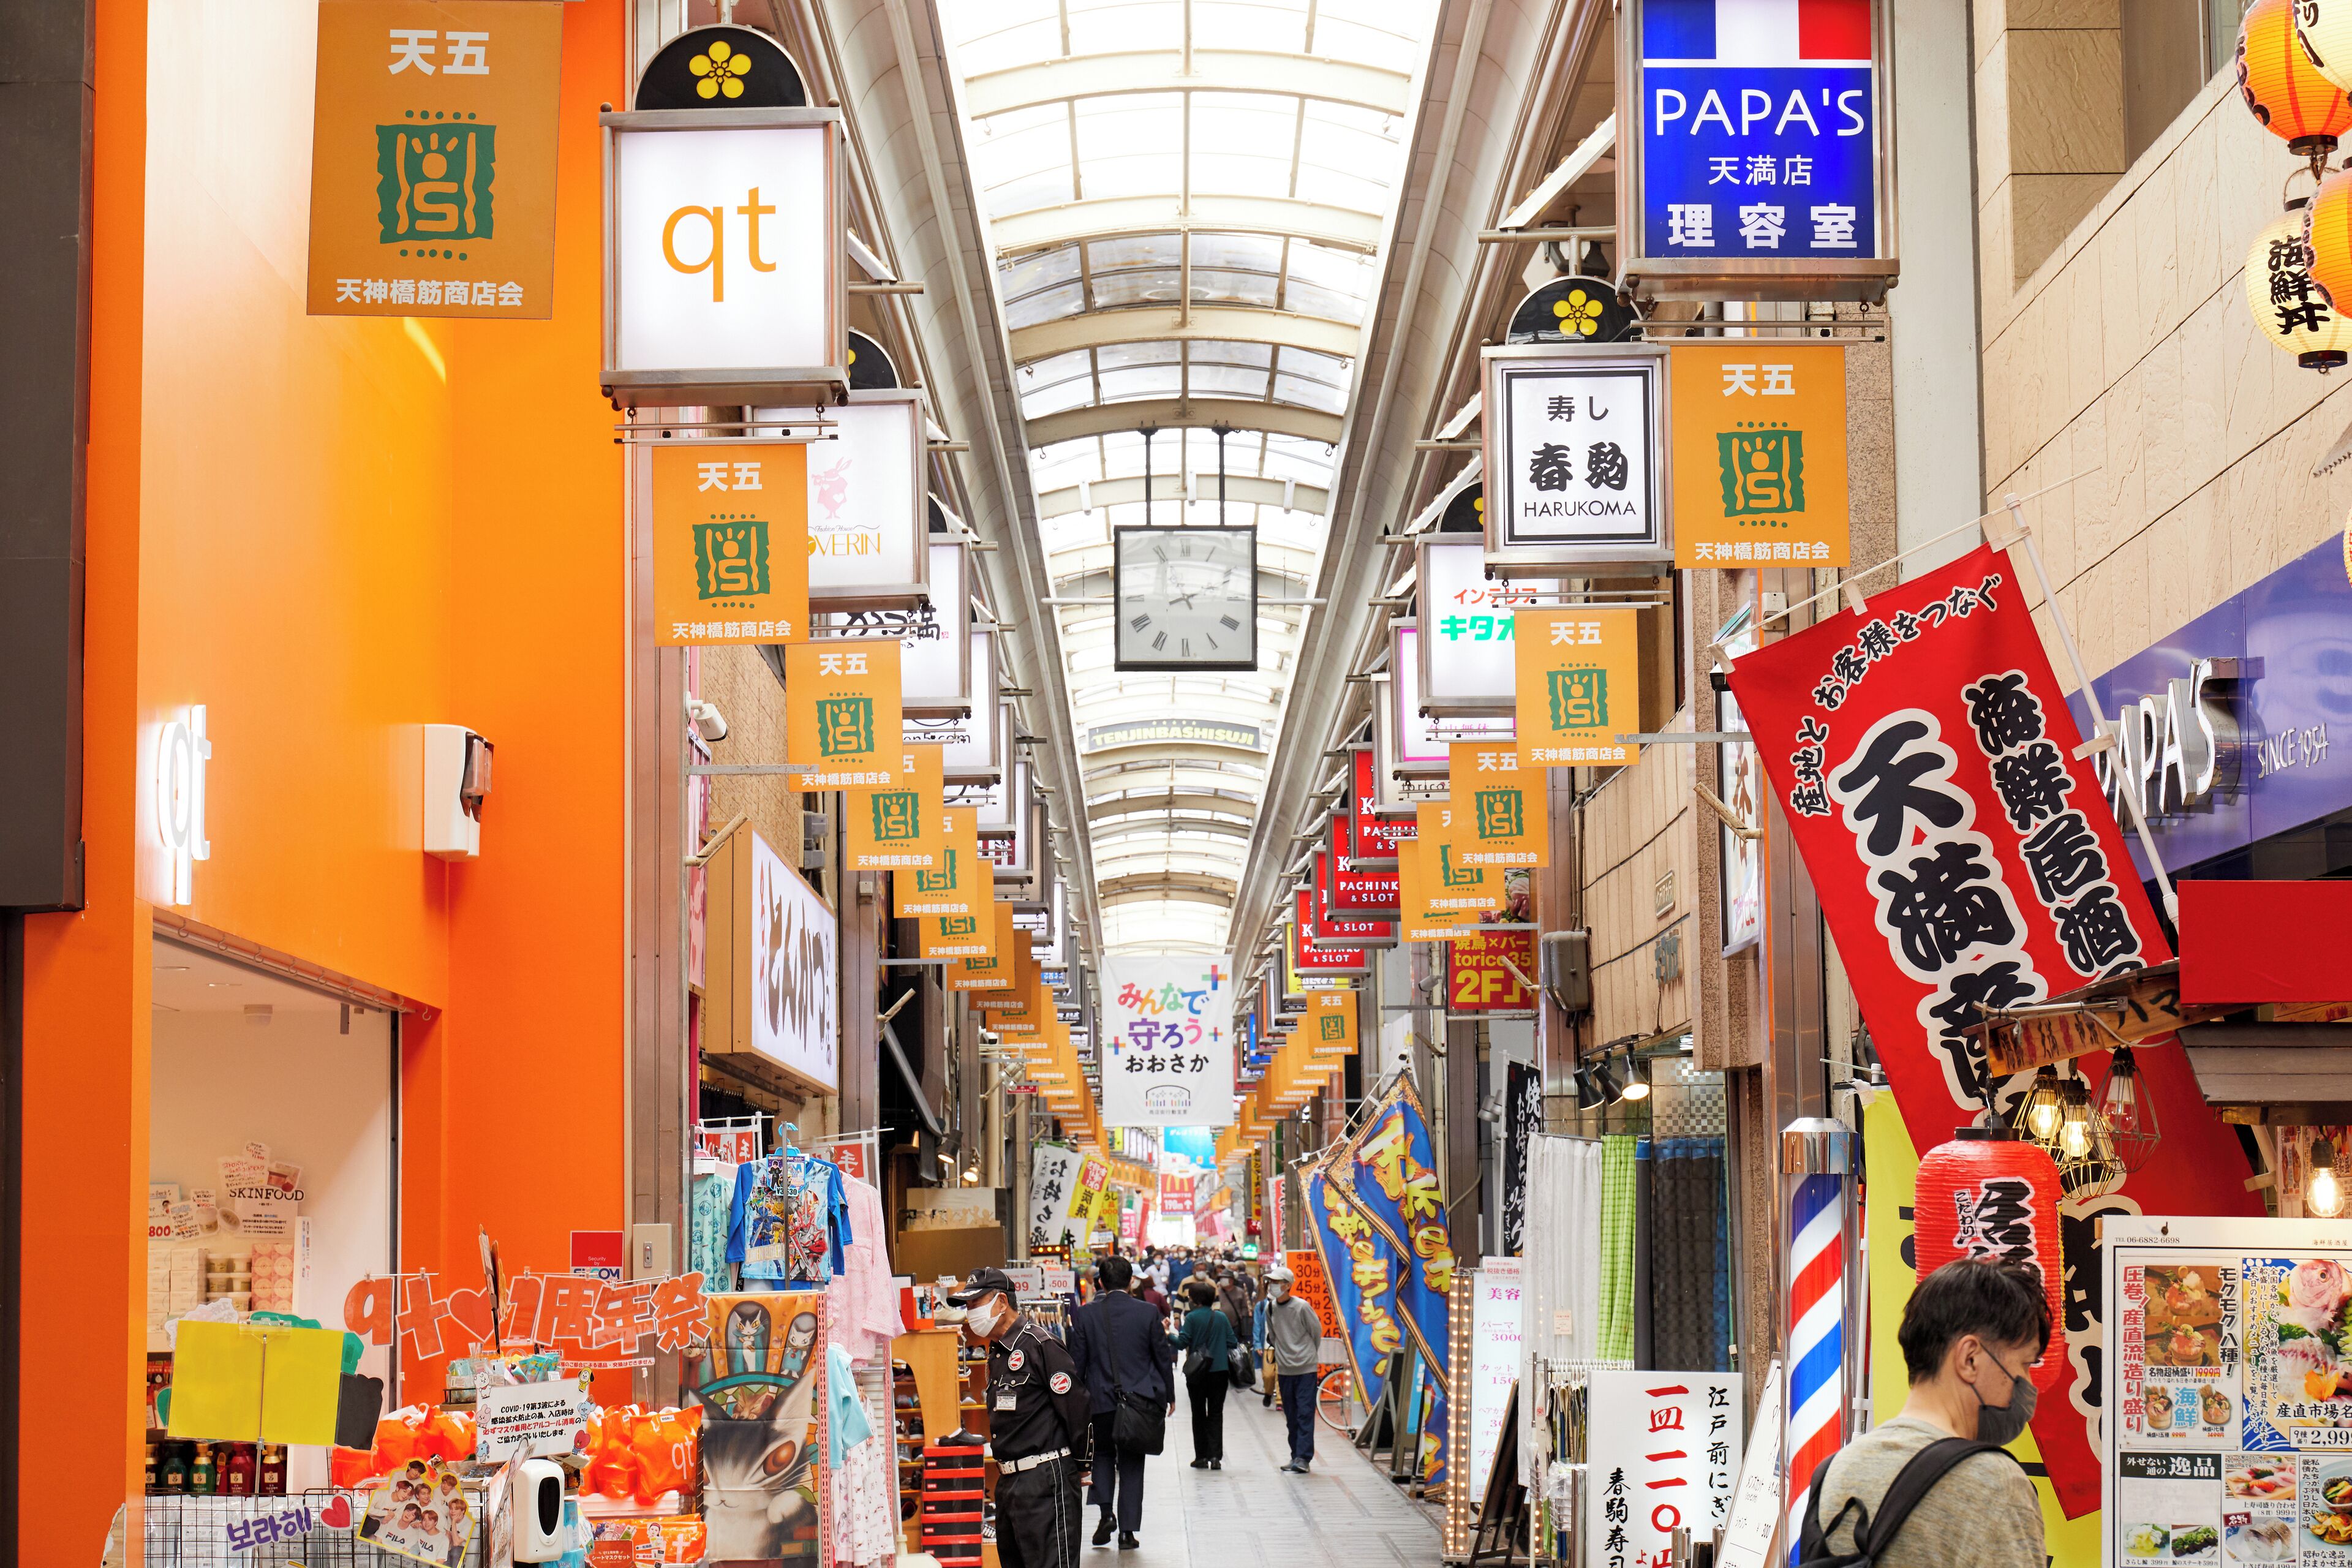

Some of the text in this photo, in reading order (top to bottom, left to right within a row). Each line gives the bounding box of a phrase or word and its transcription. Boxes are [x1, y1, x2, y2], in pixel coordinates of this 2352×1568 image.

[388, 29, 489, 75] 天五
[1656, 88, 1864, 137] PAPA'S
[1708, 154, 1812, 186] 天満店
[1667, 202, 1857, 249] 理容室
[662, 186, 776, 302] qt
[336, 278, 524, 307] 天神橋筋商店会
[1722, 364, 1795, 398] 天五
[1548, 395, 1608, 423] 寿し
[697, 462, 762, 492] 天五
[1524, 500, 1636, 518] HARUKOMA
[1695, 542, 1830, 560] 天神橋筋商店会
[672, 620, 791, 639] 天神橋筋商店会
[1550, 622, 1602, 646] 天五
[1812, 574, 2003, 712] お客様をつなぐ
[819, 654, 868, 676] 天五
[1091, 726, 1254, 746] TENJINBASHISUJI
[1531, 747, 1626, 761] 天神橋筋商店会
[2258, 722, 2329, 778] SINCE 1954
[1477, 752, 1518, 771] 天五
[802, 771, 891, 786] 天神橋筋商店会
[158, 704, 211, 905] qt
[858, 854, 933, 866] 天神橋筋商店会
[1463, 853, 1537, 864] 天神橋筋商店会
[1362, 894, 1394, 902] SLOT
[1430, 898, 1496, 908] 天神橋筋商店会
[903, 903, 968, 913] 天神橋筋商店会
[1344, 923, 1374, 932] SLOT
[929, 945, 987, 956] 天神橋筋商店会
[954, 979, 1008, 988] 天神橋筋商店会
[1117, 982, 1210, 1016] みんなで
[1321, 996, 1342, 1006] 天五
[1128, 1017, 1203, 1051] 守ろう
[1125, 1054, 1209, 1073] おおさか
[229, 1188, 304, 1201] SKINFOOD
[1956, 1191, 1974, 1236] こだわり
[1296, 1265, 1320, 1278] 30分
[1296, 1281, 1320, 1294] 45分
[2149, 1367, 2220, 1377] 名物超桶盛り 1999円
[2174, 1387, 2198, 1427] 海鮮
[483, 1417, 581, 1435] 必ずマスク着用とアルコール消毒の
[491, 1409, 574, 1425] 感染拡大防止の為、入店時は
[2311, 1430, 2352, 1445] 2,99
[672, 1436, 695, 1479] qt
[1707, 1387, 1732, 1528] 江戸前にぎ
[2127, 1457, 2166, 1466] 外せない
[2169, 1457, 2215, 1477] 逸品
[2147, 1467, 2166, 1476] 通の
[2302, 1459, 2311, 1530] 愛情たっぷり日本の味
[227, 1507, 312, 1551] 보라해
[385, 1531, 405, 1545] FILA
[420, 1539, 434, 1552] FILA
[2302, 1550, 2345, 1559] 昭和な逸品
